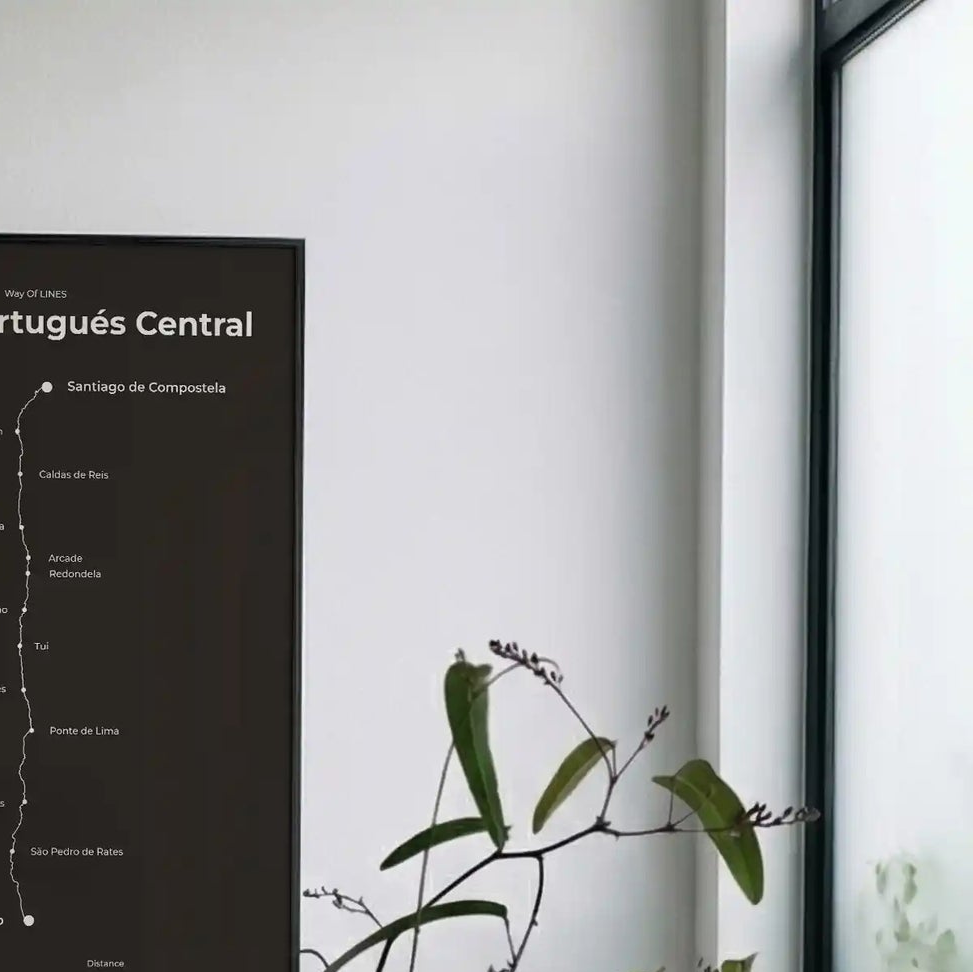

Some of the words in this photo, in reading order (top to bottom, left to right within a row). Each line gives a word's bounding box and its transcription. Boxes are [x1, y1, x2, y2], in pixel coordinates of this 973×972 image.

[4, 289, 26, 300] Way
[26, 288, 39, 298] Of
[39, 289, 68, 299] LINES
[136, 311, 252, 337] Central
[67, 379, 126, 395] Santiago
[128, 380, 146, 393] de
[148, 381, 227, 396] Compostela
[38, 469, 72, 479] Caldas
[72, 470, 87, 480] de
[88, 470, 109, 480] Reis
[47, 553, 84, 563] Arcade
[49, 569, 102, 579] Redondela
[33, 641, 50, 651] Tui
[49, 725, 79, 736] Ponte
[80, 726, 94, 736] de
[95, 726, 120, 736] Lima
[30, 846, 49, 857] São
[50, 846, 81, 856] Pedro
[81, 847, 95, 857] de
[96, 846, 124, 857] Rates
[86, 959, 125, 968] Distance
